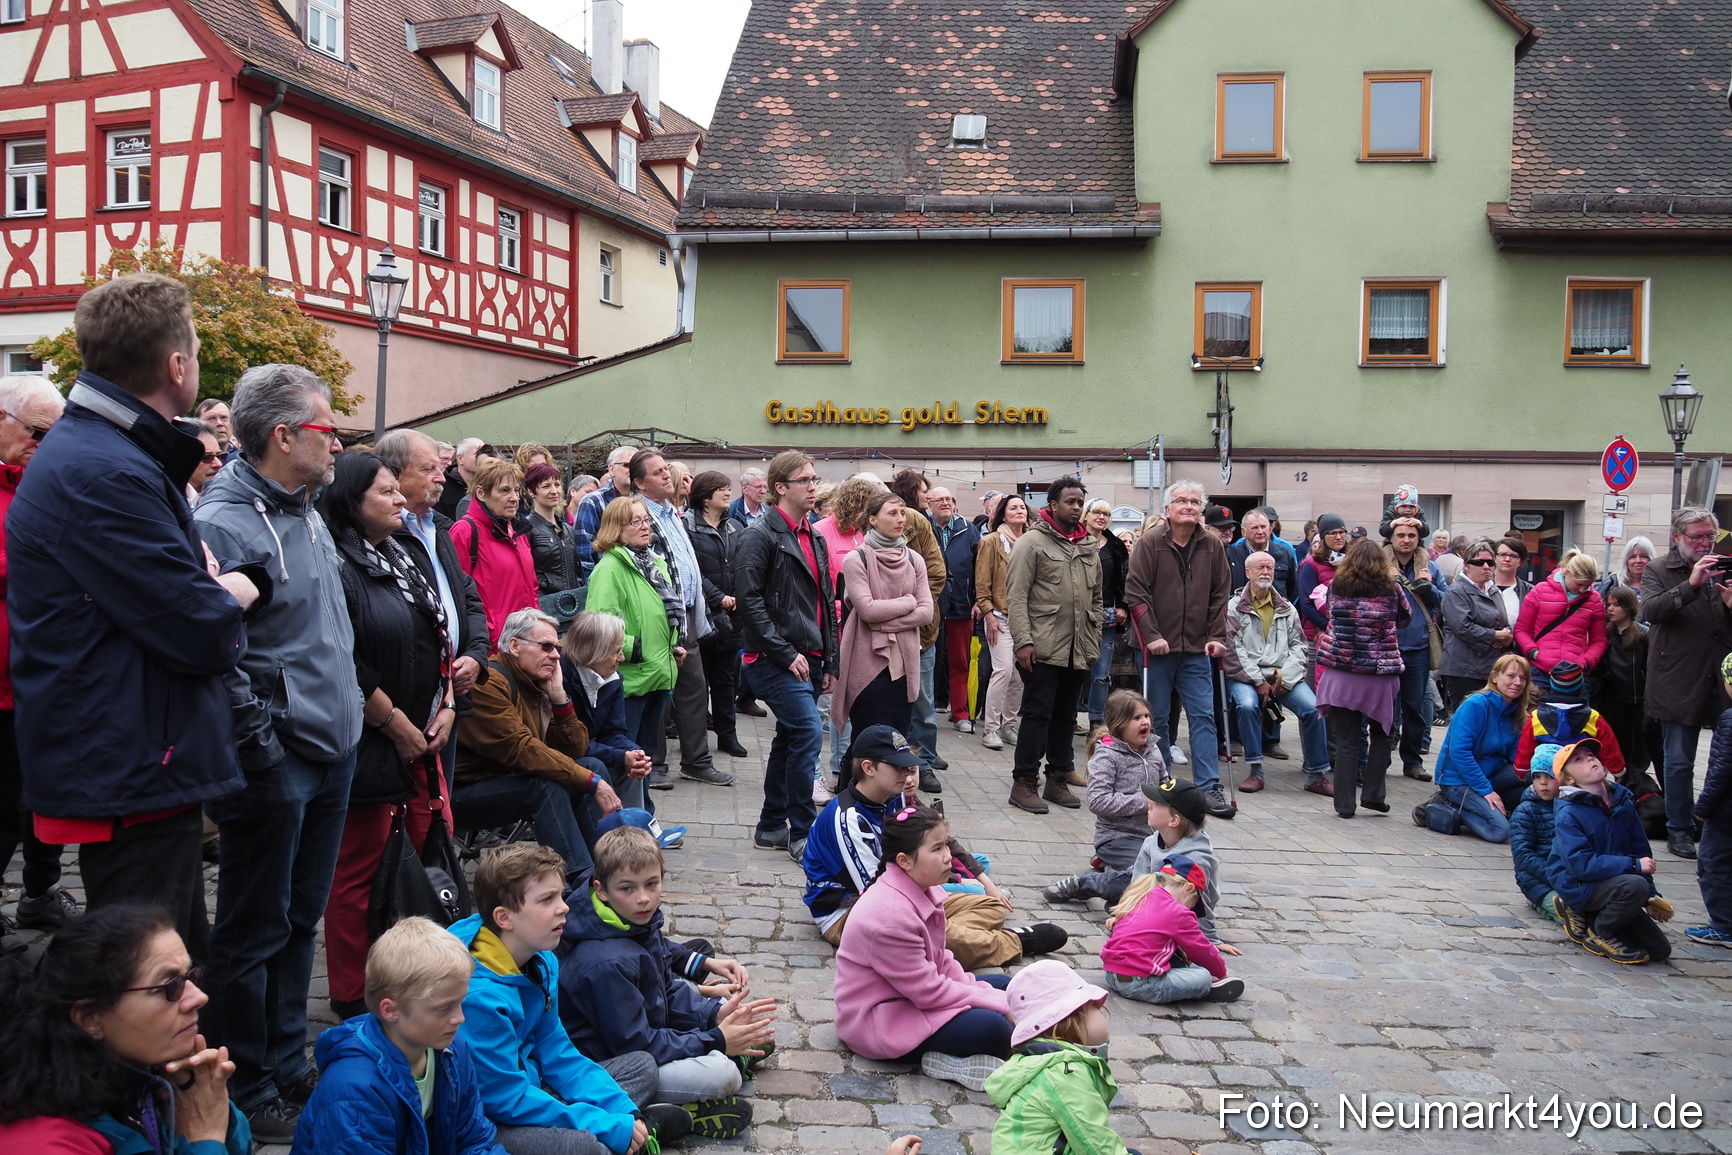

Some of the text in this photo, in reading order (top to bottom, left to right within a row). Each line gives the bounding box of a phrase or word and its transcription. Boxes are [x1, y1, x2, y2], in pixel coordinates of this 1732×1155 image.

[765, 400, 889, 424] Gasthaus
[975, 400, 1048, 424] Stern
[1294, 471, 1308, 482] 12
